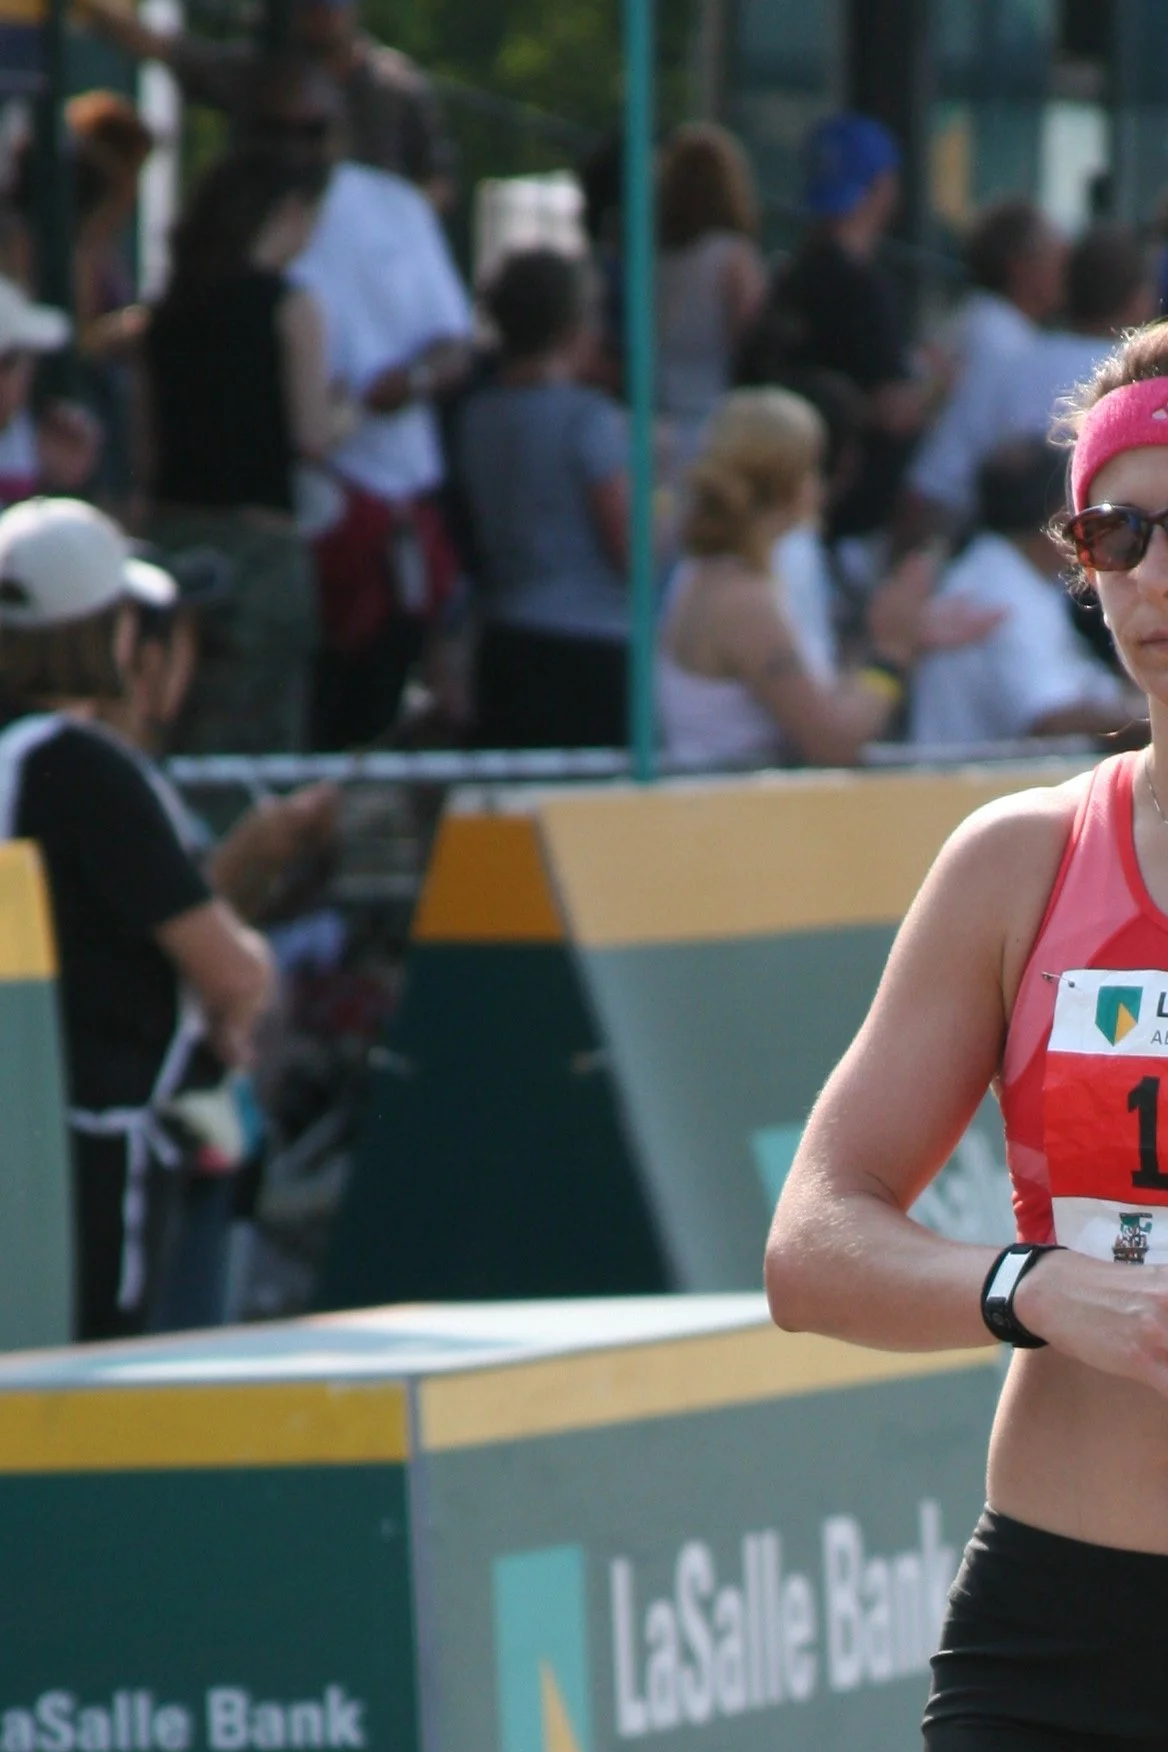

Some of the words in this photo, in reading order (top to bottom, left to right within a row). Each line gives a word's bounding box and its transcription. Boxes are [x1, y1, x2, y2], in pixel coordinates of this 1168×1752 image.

[609, 1527, 817, 1740] LaSalle
[820, 1496, 958, 1693] Bank
[205, 1682, 366, 1752] Bank
